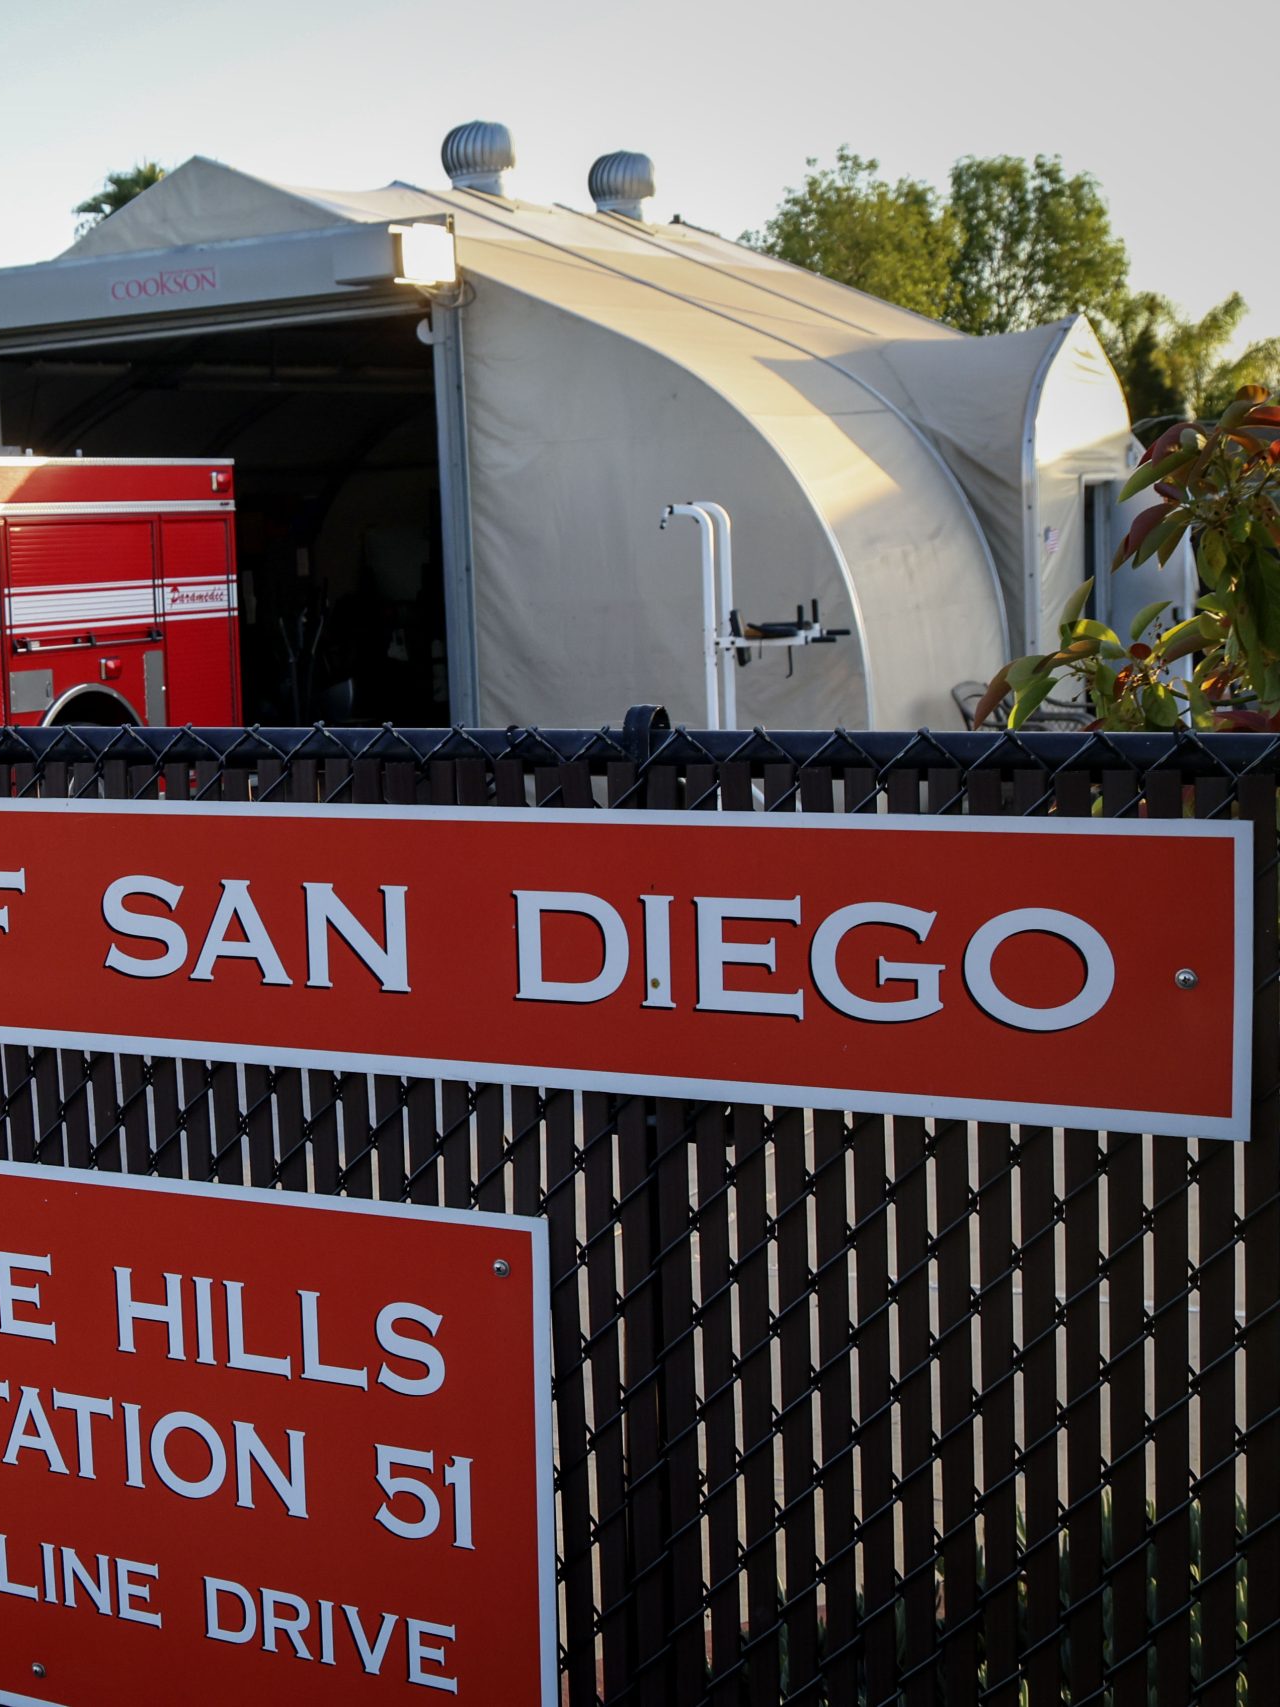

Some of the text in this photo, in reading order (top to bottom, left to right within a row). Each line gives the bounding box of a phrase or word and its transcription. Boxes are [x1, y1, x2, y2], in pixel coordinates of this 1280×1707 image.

[111, 270, 216, 301] COOKSON
[103, 875, 411, 993] SAN
[513, 890, 1114, 1032] DIEGO
[114, 1265, 445, 1397] HILLS
[374, 1443, 476, 1551] 51
[203, 1575, 458, 1695] DRIVE
